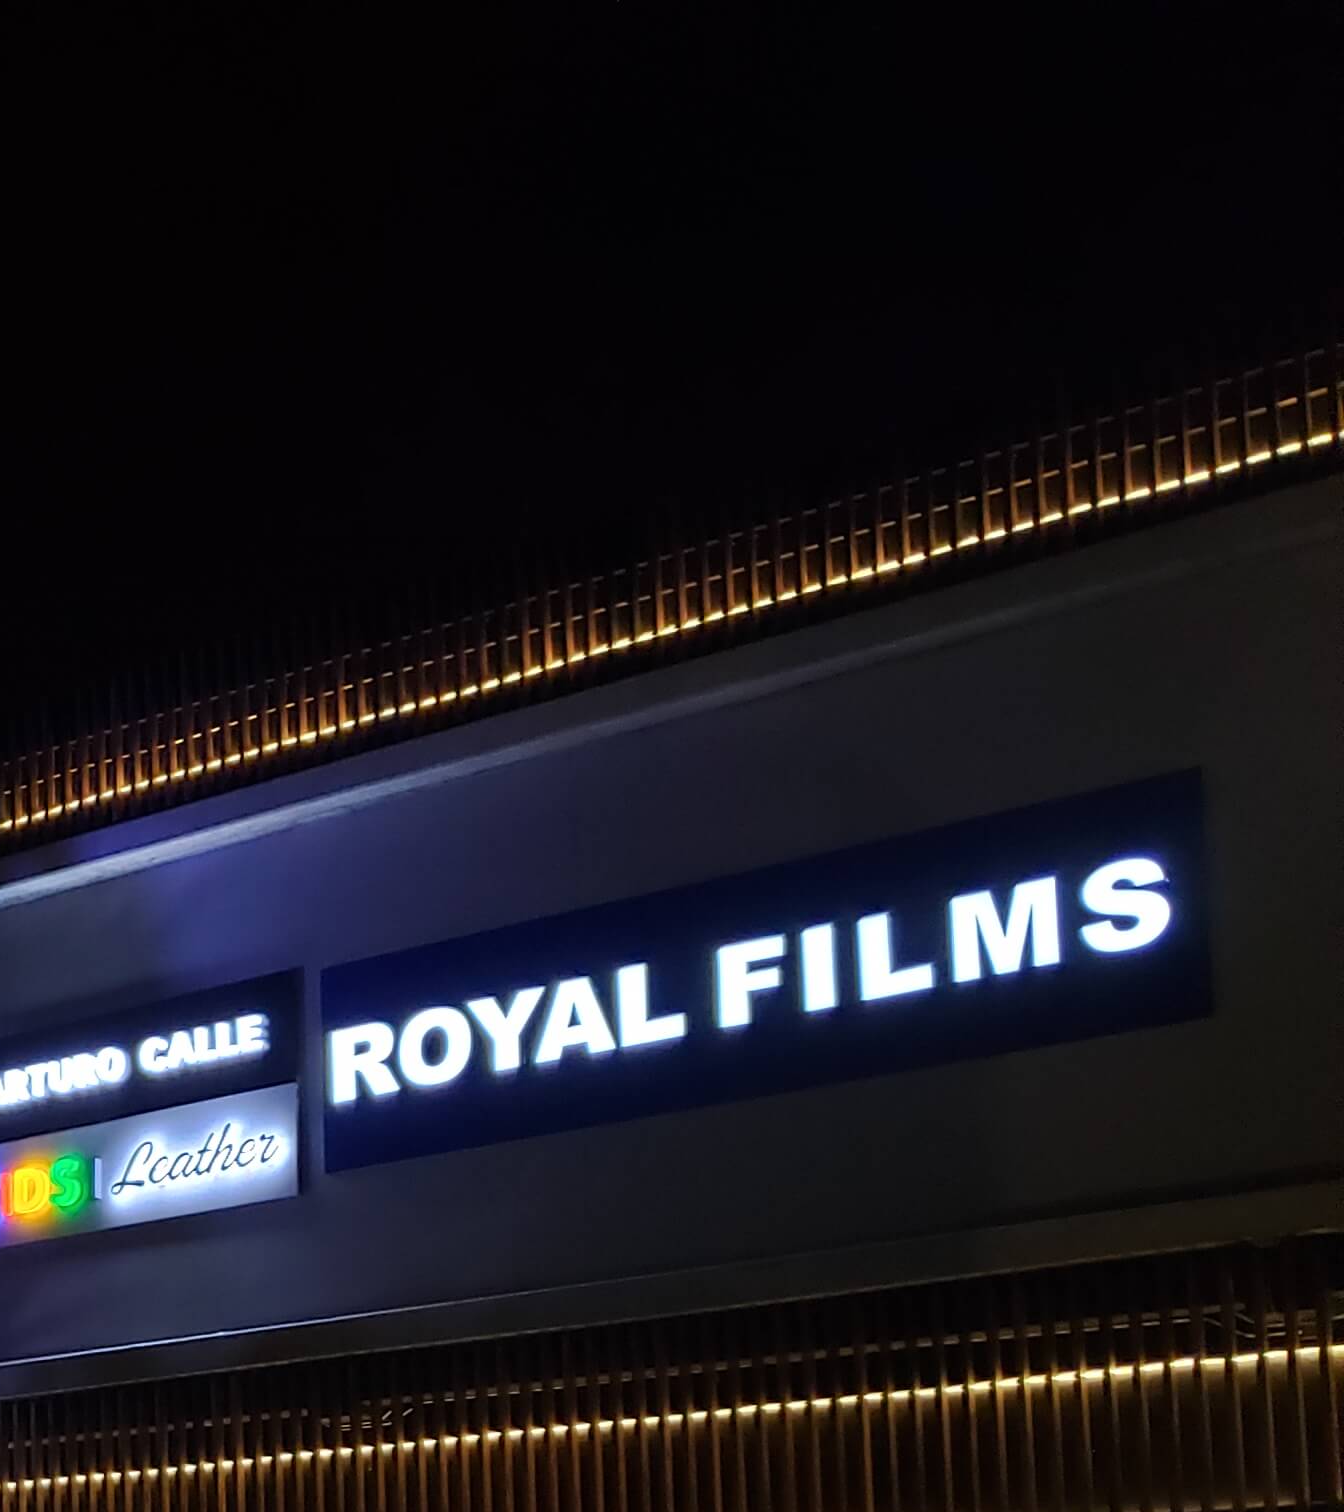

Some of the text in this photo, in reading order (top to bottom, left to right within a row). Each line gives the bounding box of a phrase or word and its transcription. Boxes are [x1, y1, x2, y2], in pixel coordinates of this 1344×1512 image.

[325, 856, 1173, 1106] ROYAL FILMS
[139, 1013, 270, 1073] CALLE
[110, 1122, 279, 1196] Leather
